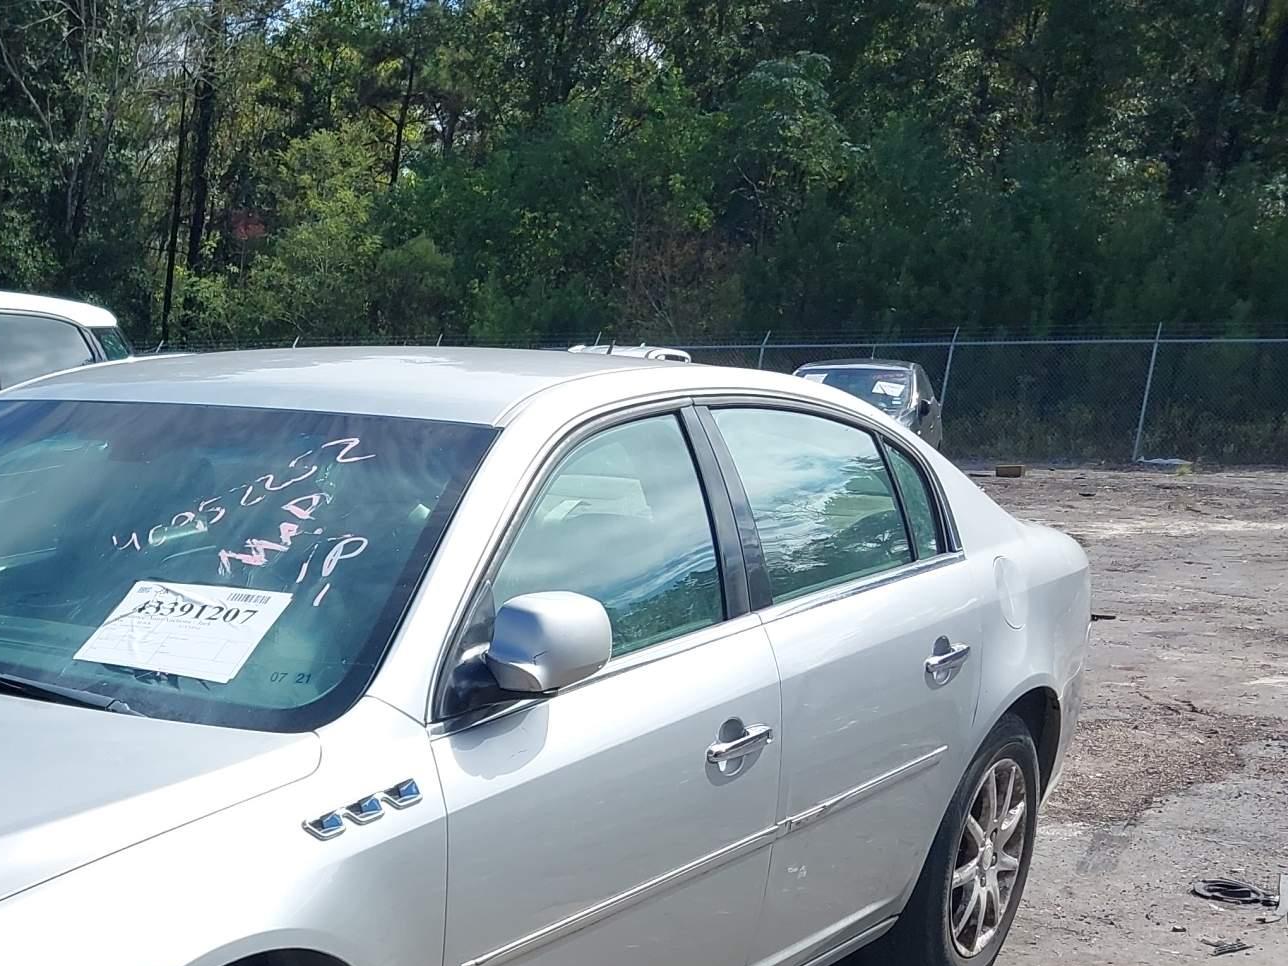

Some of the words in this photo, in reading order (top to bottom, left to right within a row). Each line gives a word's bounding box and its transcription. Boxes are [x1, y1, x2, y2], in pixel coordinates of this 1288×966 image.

[137, 599, 259, 625] 43391207
[270, 671, 288, 684] 07
[295, 672, 312, 684] 21
